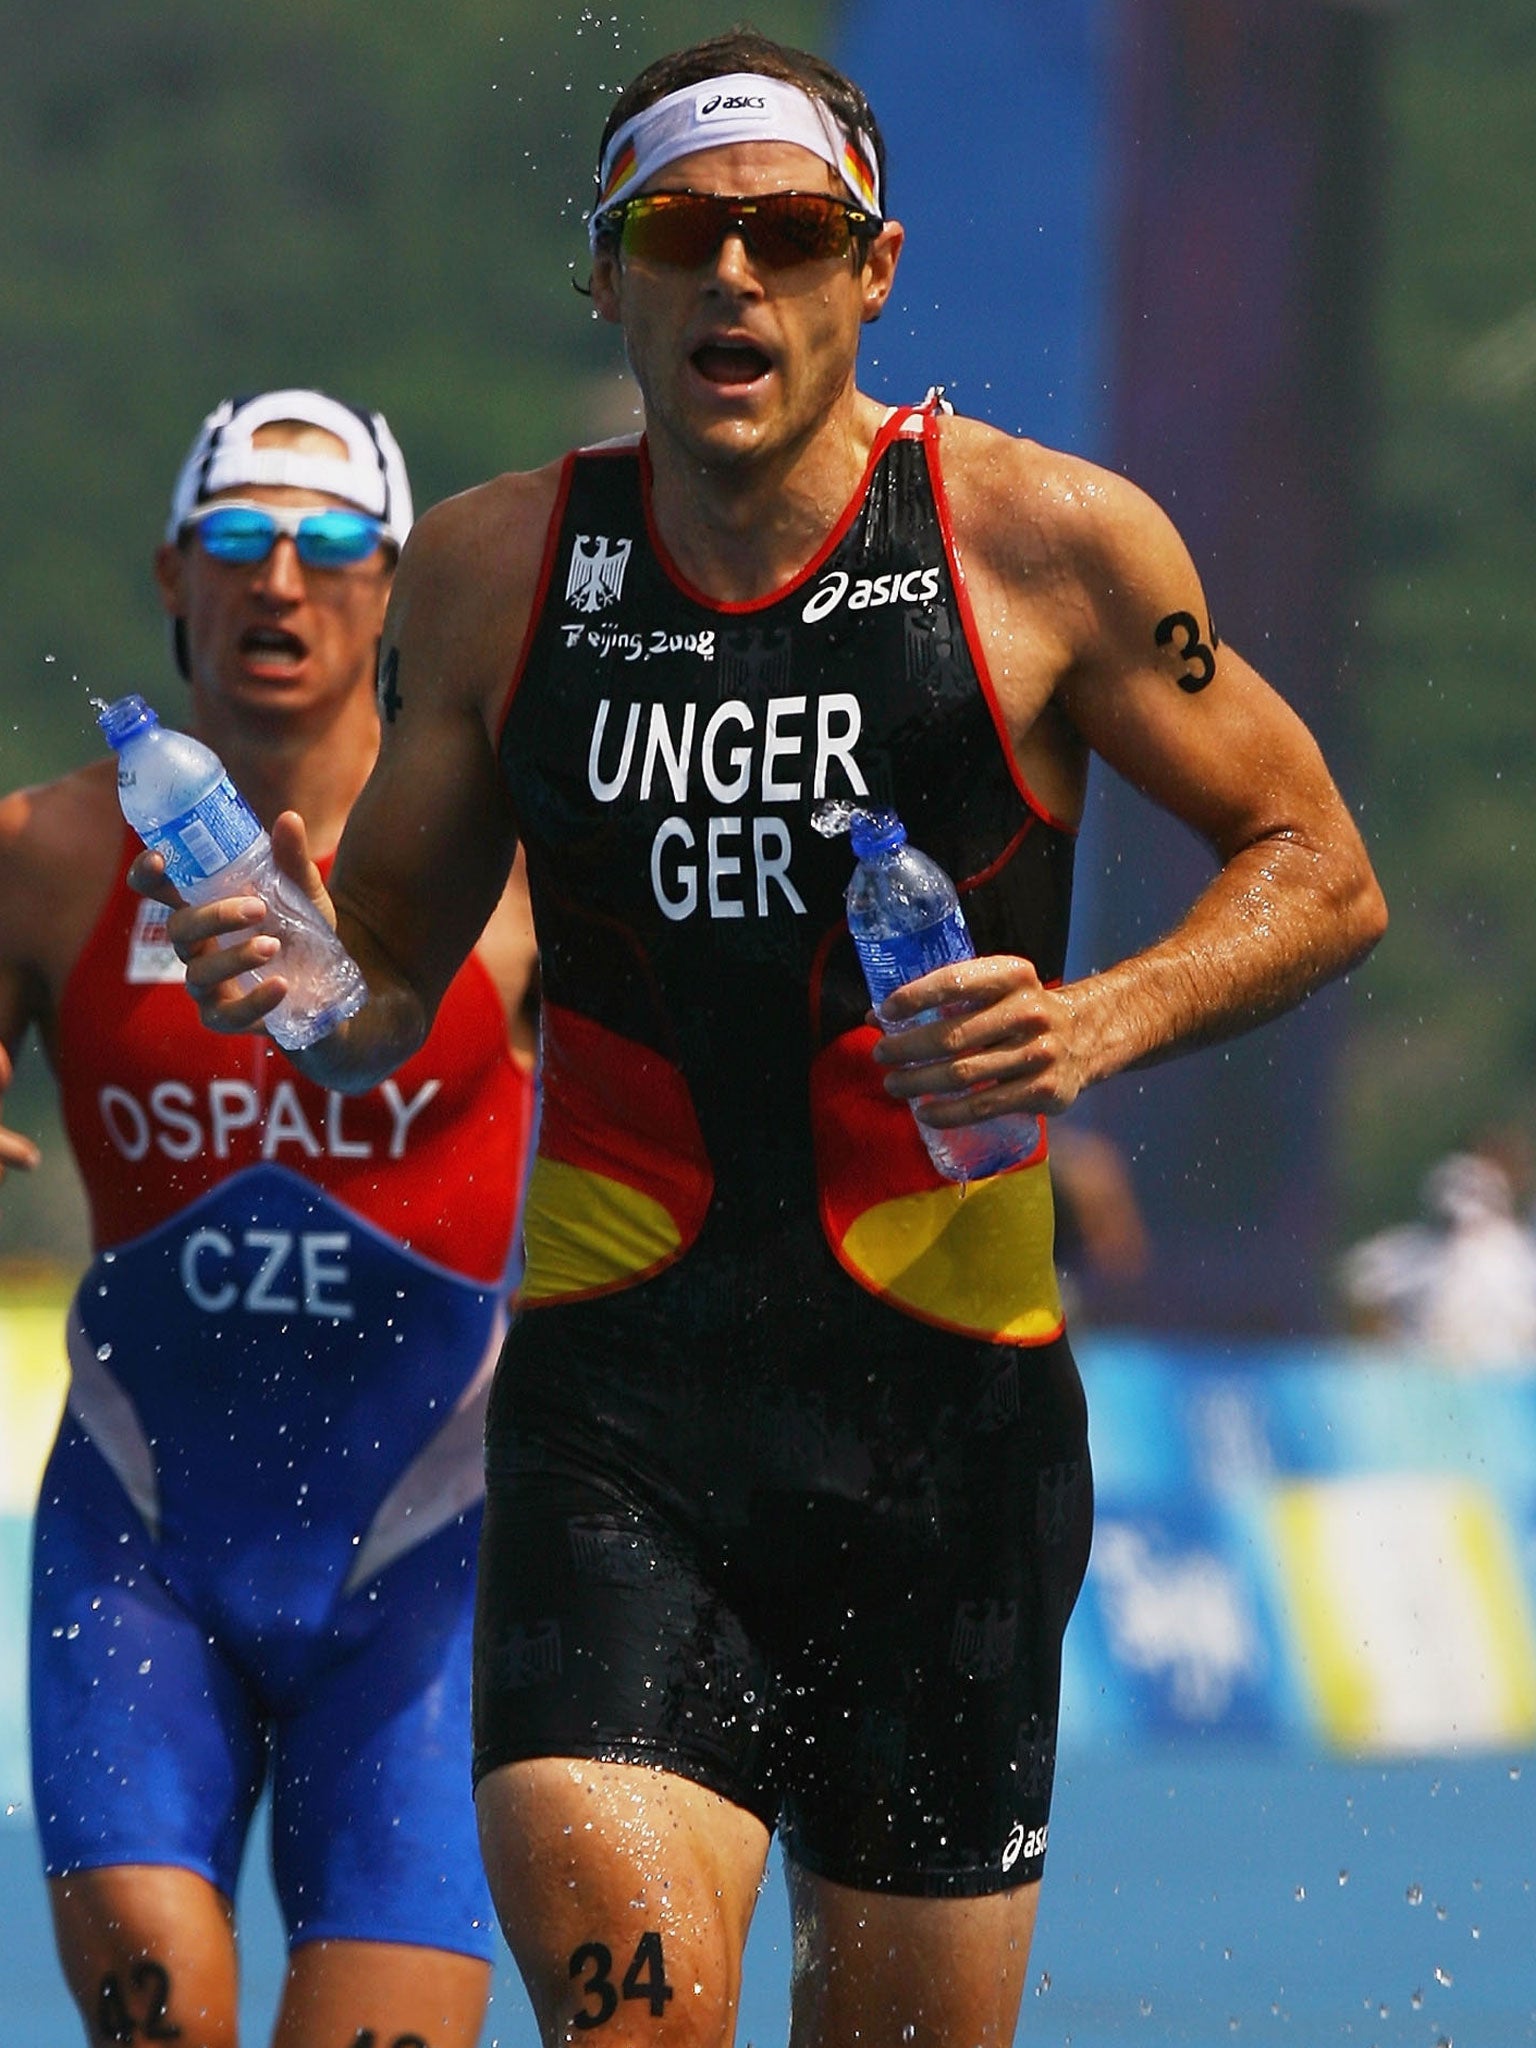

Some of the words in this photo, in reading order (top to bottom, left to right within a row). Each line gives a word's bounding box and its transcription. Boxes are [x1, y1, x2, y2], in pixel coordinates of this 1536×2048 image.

[722, 96, 767, 109] asics
[847, 566, 940, 610] asics
[560, 622, 643, 661] Beijing
[648, 630, 716, 656] 2008
[1155, 611, 1219, 694] 3
[588, 693, 870, 803] UNGER
[650, 816, 808, 921] GER
[99, 1079, 443, 1162] OSPALY
[180, 1229, 356, 1319] CZE
[1023, 1825, 1049, 1858] asi
[569, 1931, 673, 2030] 34
